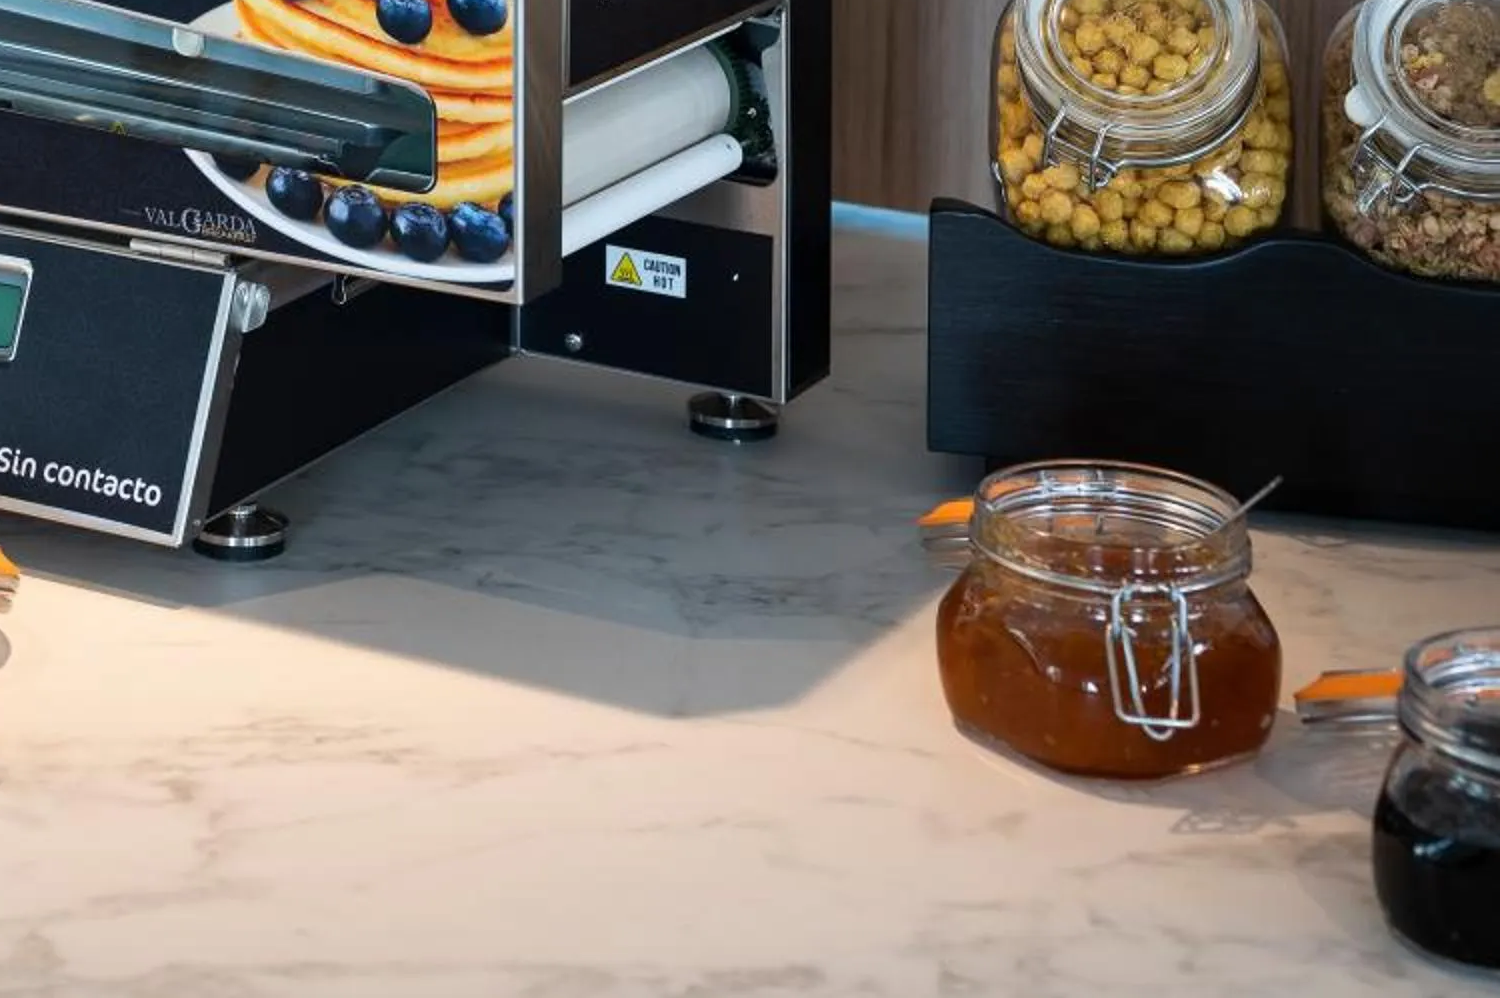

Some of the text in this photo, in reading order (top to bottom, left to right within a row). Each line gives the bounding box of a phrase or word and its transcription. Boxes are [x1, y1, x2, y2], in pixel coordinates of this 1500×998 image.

[643, 258, 681, 277] CAUTION
[653, 276, 675, 290] HOT
[43, 462, 161, 506] contacto
